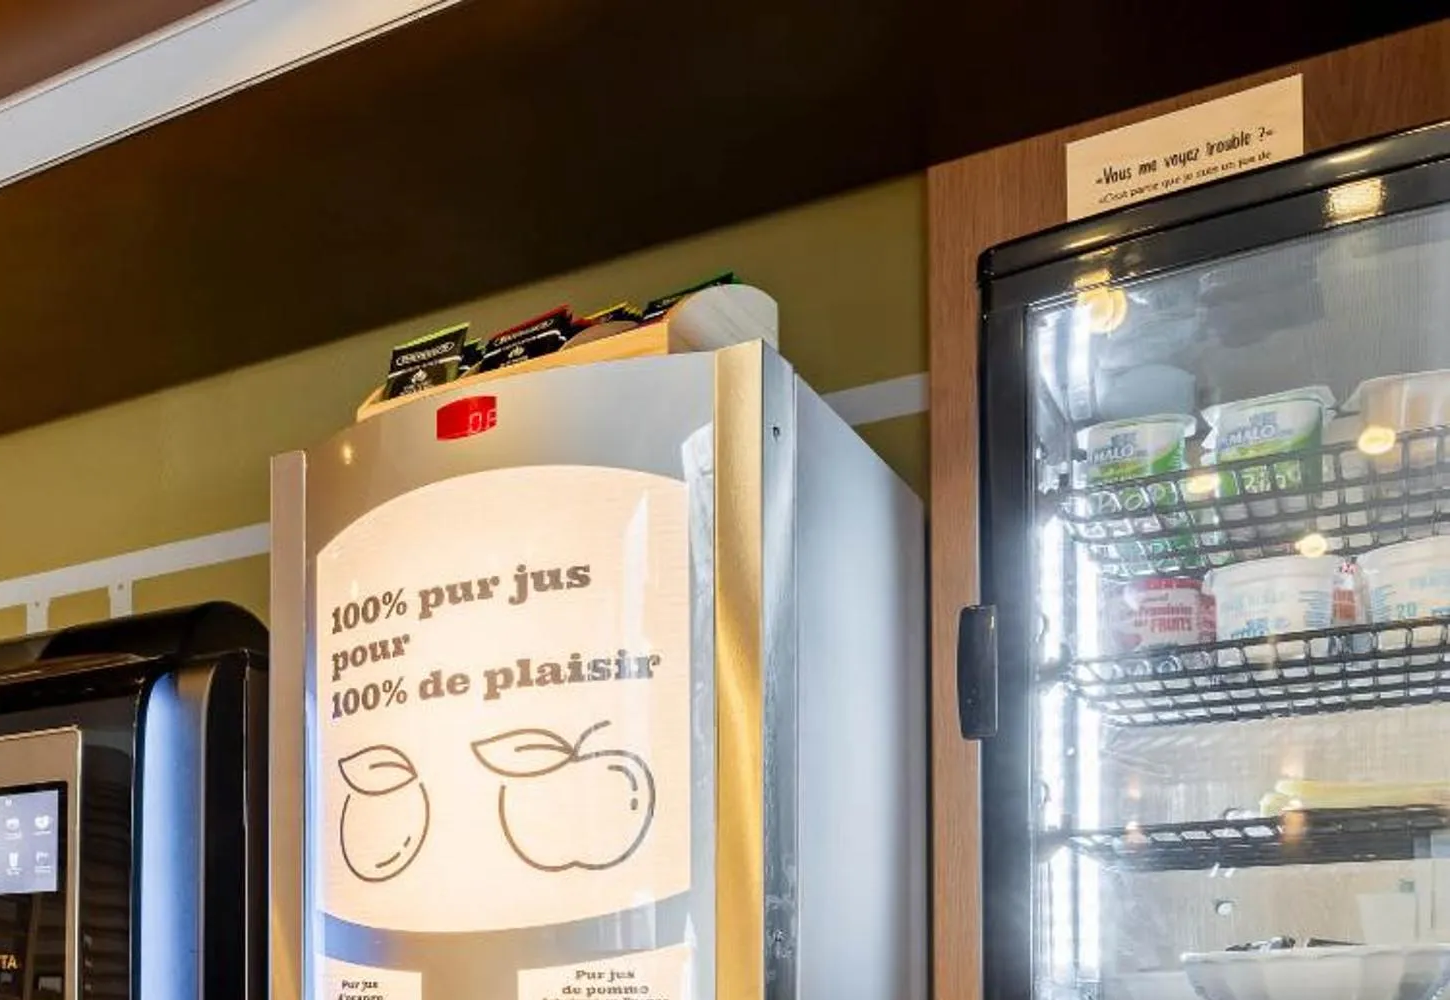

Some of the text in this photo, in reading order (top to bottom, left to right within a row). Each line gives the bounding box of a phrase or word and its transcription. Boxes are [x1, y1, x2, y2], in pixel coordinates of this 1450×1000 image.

[1138, 160, 1157, 176] me
[1163, 147, 1200, 169] voyez
[1205, 130, 1251, 156] trouble
[331, 563, 591, 635] 100% pur jus
[331, 633, 411, 682] pour
[331, 648, 662, 720] 100% de plaisir
[562, 985, 650, 997] de pomme
[575, 969, 635, 982] Pur jus
